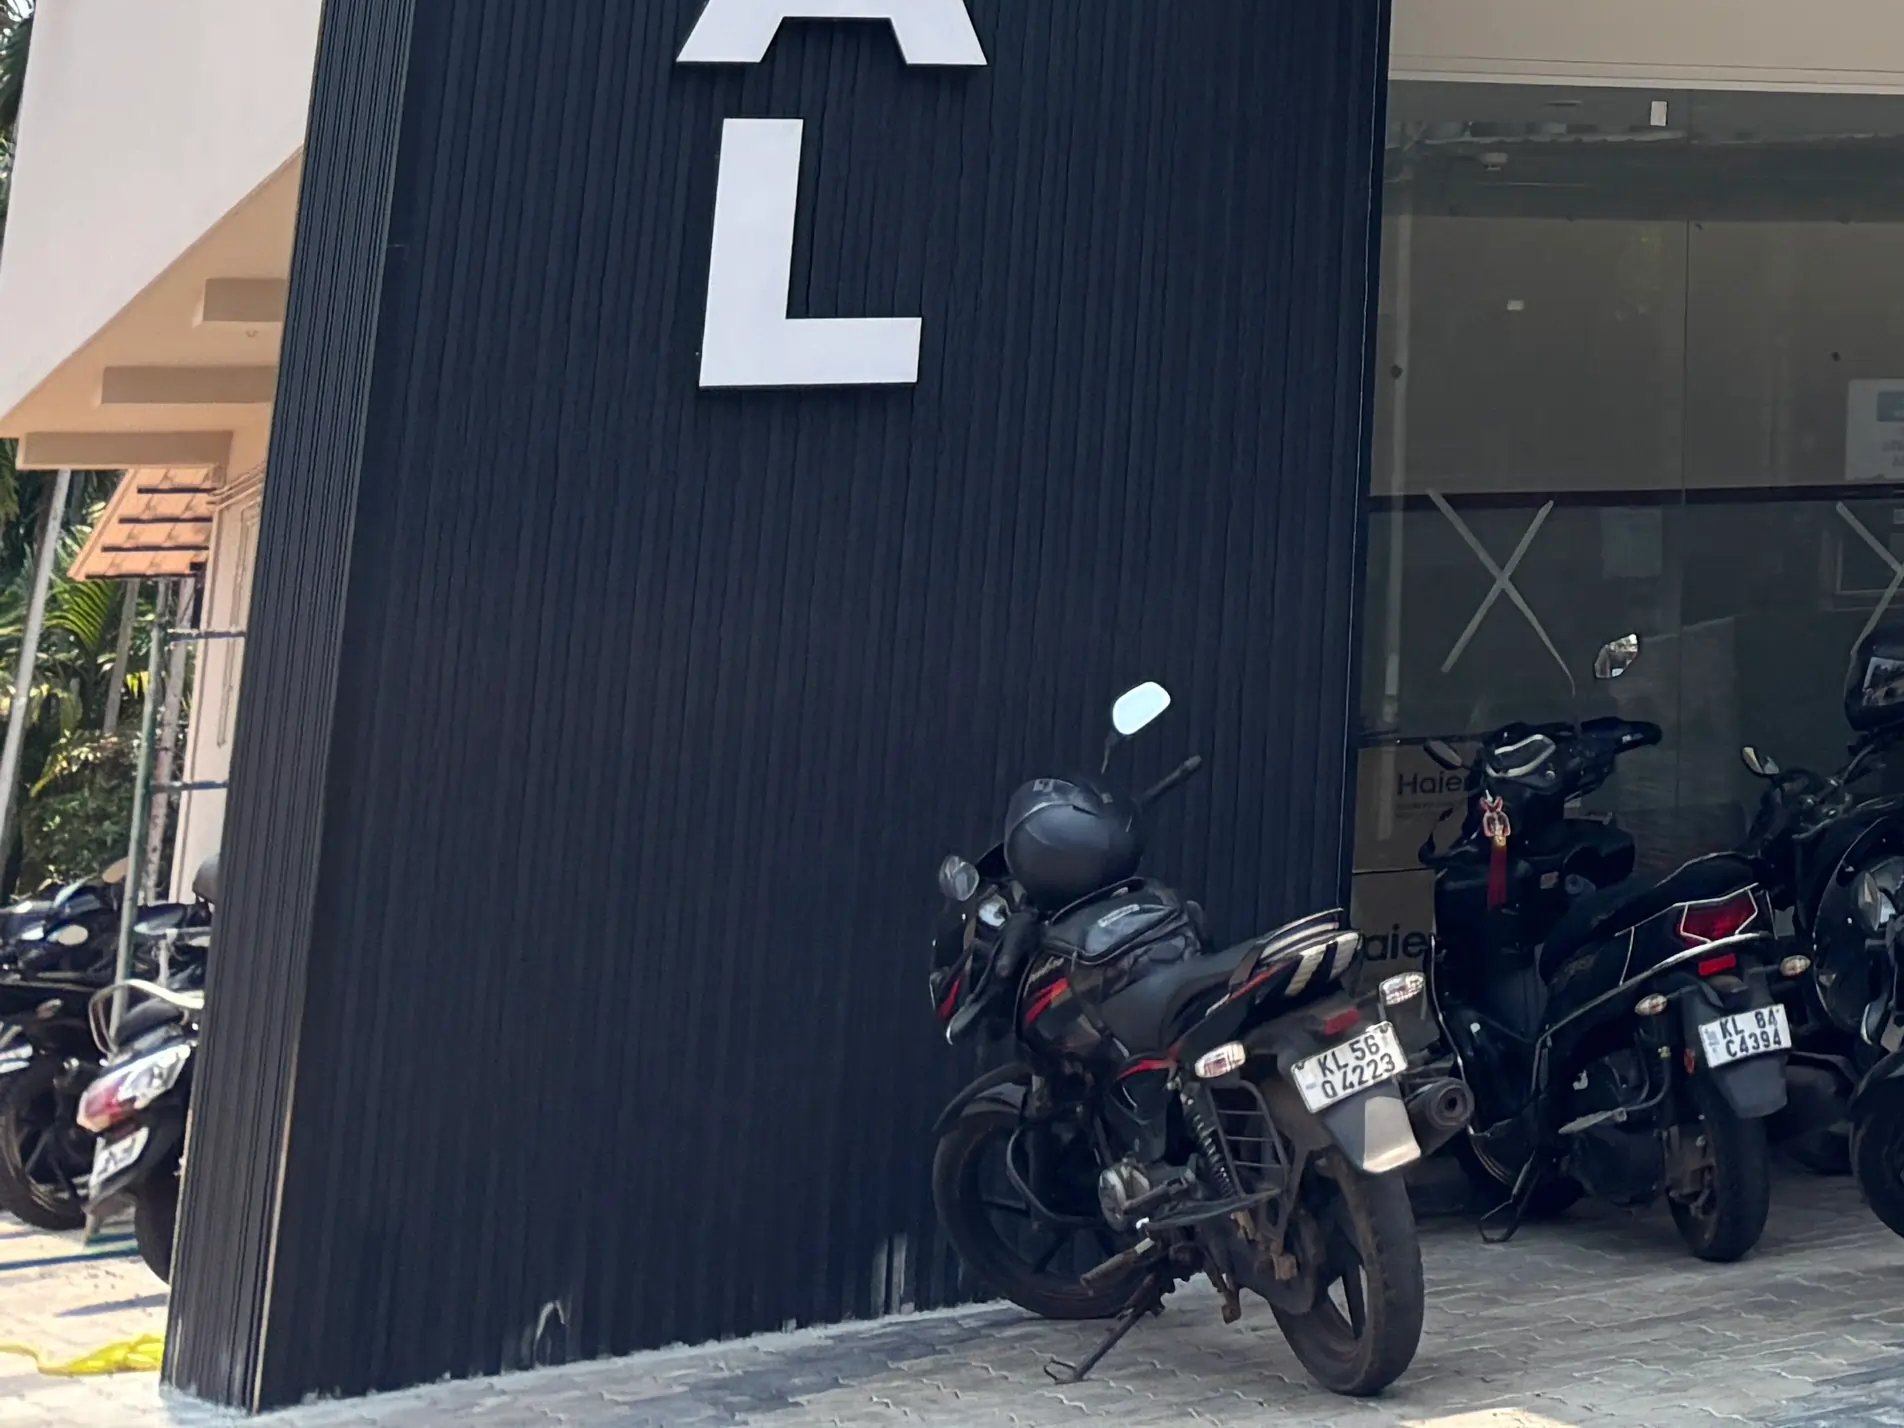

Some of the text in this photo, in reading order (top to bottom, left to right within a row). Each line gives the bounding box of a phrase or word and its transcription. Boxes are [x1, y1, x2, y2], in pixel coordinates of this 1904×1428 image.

[1396, 770, 1463, 796] Haie
[1719, 1016, 1746, 1040] KL
[1317, 1033, 1381, 1078] KL 56
